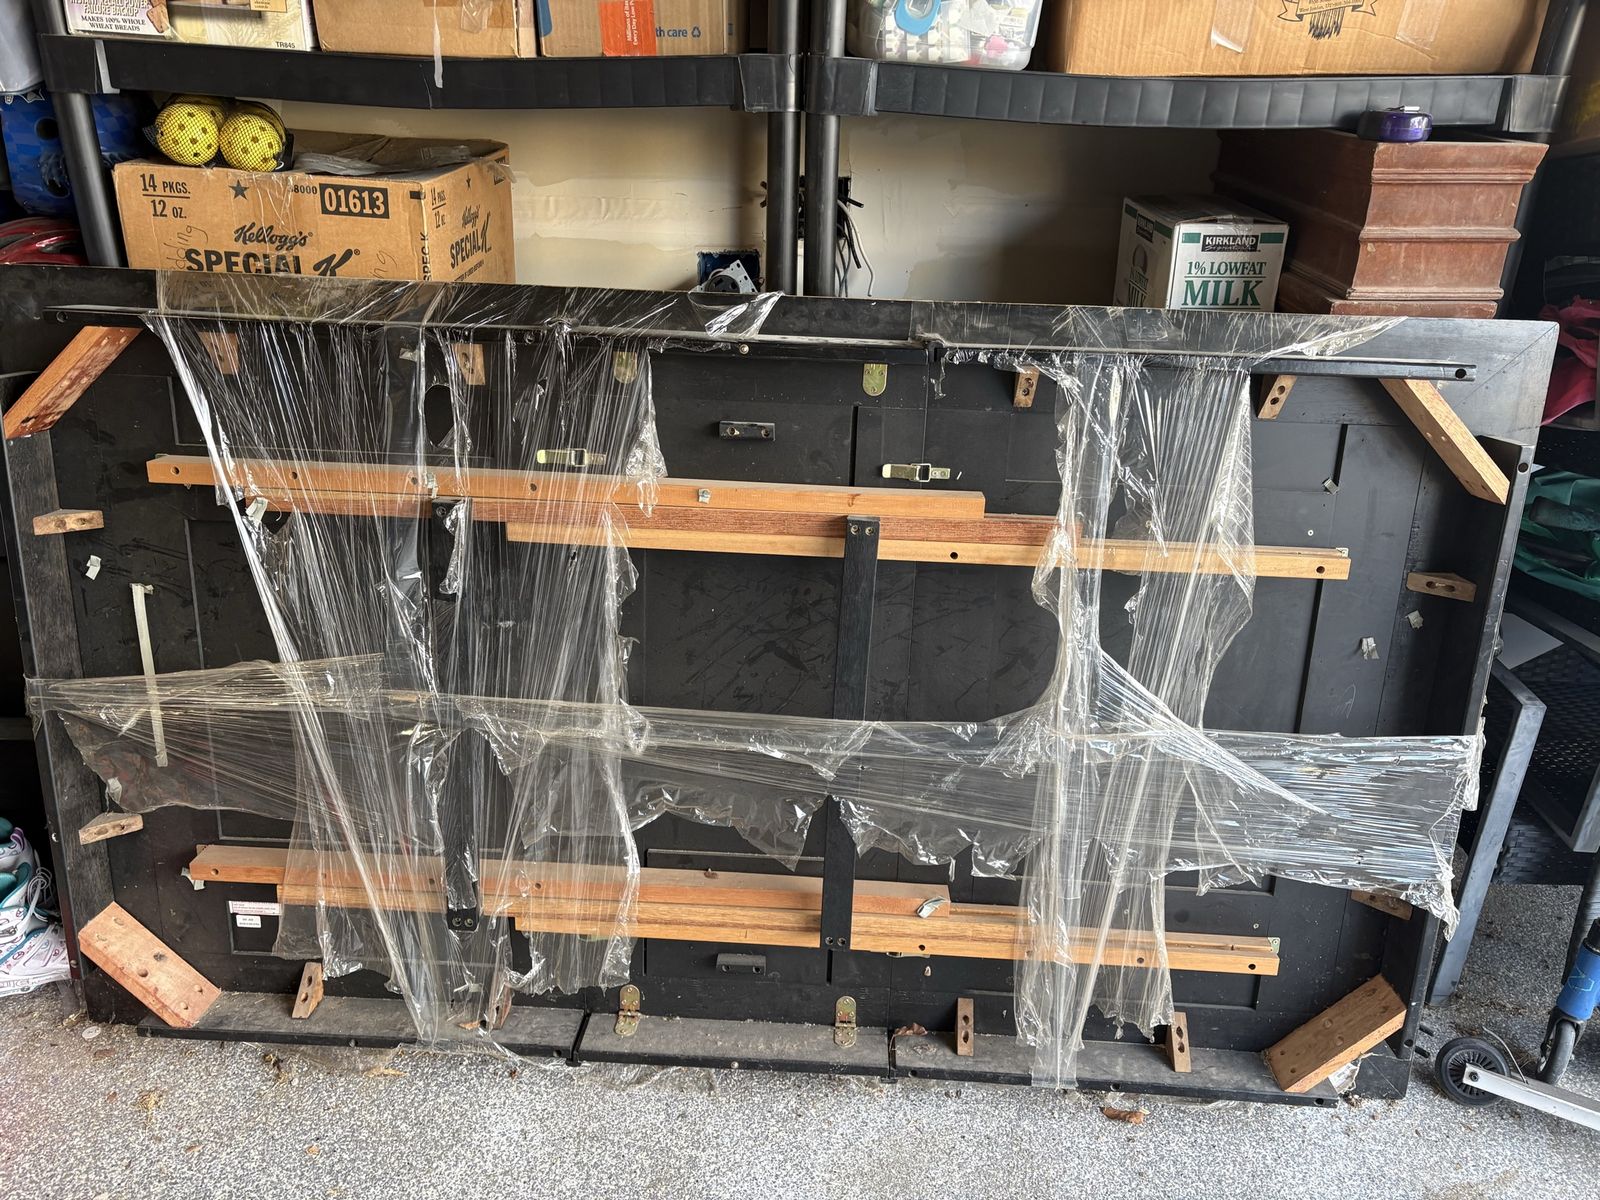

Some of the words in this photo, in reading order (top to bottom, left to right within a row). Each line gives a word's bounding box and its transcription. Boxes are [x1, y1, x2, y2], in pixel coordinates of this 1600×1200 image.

[84, 5, 110, 15] FAILURE
[112, 7, 138, 17] BACKUP
[667, 28, 688, 38] care
[140, 173, 158, 192] 14
[162, 181, 191, 194] PKGS.
[150, 200, 168, 218] 12
[172, 206, 187, 219] OZ.
[289, 184, 318, 195] 8000
[324, 187, 386, 216] 01613
[234, 222, 307, 252] Kellogg's
[420, 232, 428, 242] K
[1206, 236, 1256, 246] KIRKLAND
[450, 229, 480, 270] SPECIAL
[1187, 260, 1206, 275] 1%
[1209, 261, 1266, 276] LOWFAT
[1182, 280, 1264, 306] MILK
